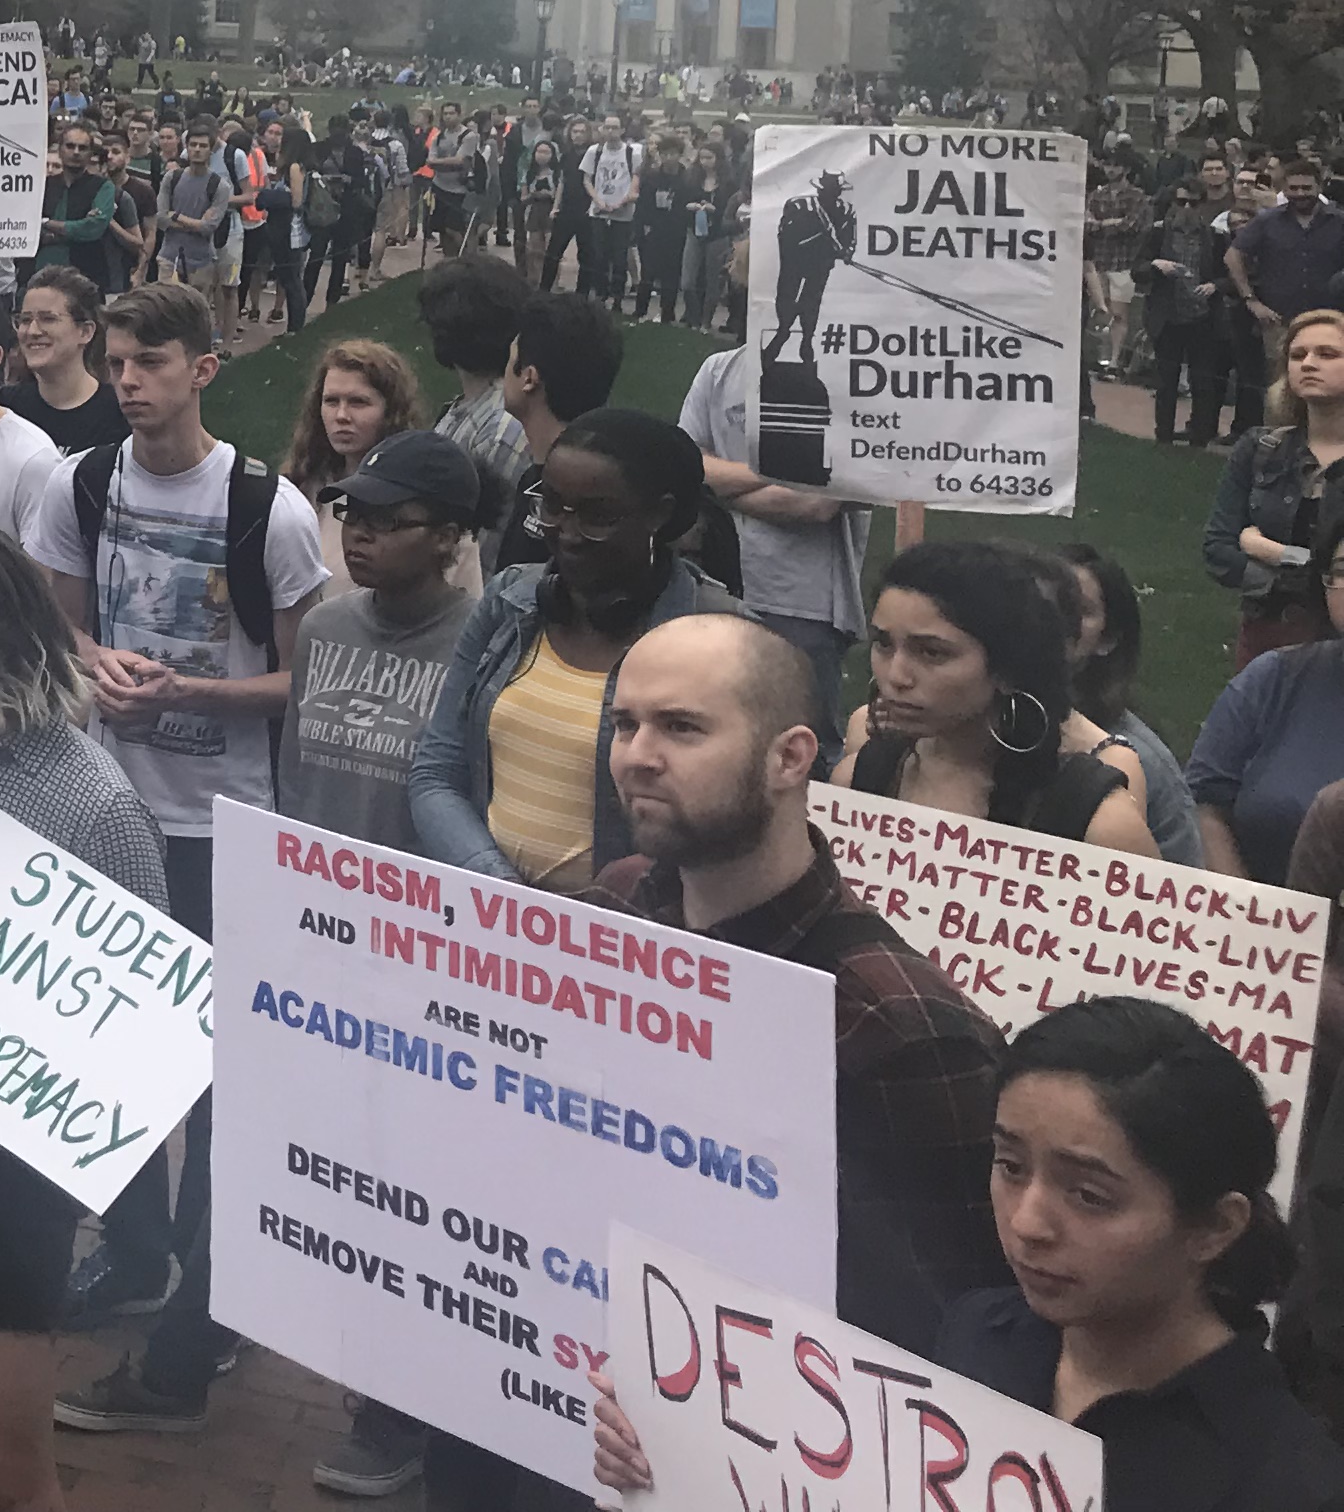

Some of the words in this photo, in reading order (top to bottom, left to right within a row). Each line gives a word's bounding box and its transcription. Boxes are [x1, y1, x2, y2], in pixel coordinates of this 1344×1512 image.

[868, 134, 929, 157] NO
[941, 135, 1059, 162] MORE
[894, 169, 1025, 218] JAIL
[867, 225, 1057, 262] DEATHS!
[821, 323, 1023, 359] #DoItLike
[849, 359, 1054, 403] Durham
[850, 411, 902, 430] text
[850, 439, 1046, 466] DefendDurham
[936, 474, 962, 494] to
[970, 473, 1054, 497] 64336
[277, 830, 454, 927] RACISM,
[470, 886, 732, 1002] VIOLENCE
[11, 852, 213, 1039] STUDEN
[299, 907, 356, 945] AND
[370, 916, 713, 1061] INTIMIDATION
[425, 1000, 480, 1038] ARE
[488, 1018, 548, 1059] NOT
[251, 980, 478, 1091] ACADEMIC
[494, 1065, 780, 1201] FREEDOMS
[287, 1142, 430, 1227] DEFEND
[442, 1207, 532, 1271] OUR
[260, 1204, 405, 1299] REMOVE
[416, 1273, 542, 1358] THEIR
[463, 1260, 519, 1299] AND
[500, 1368, 587, 1427] (LIKE
